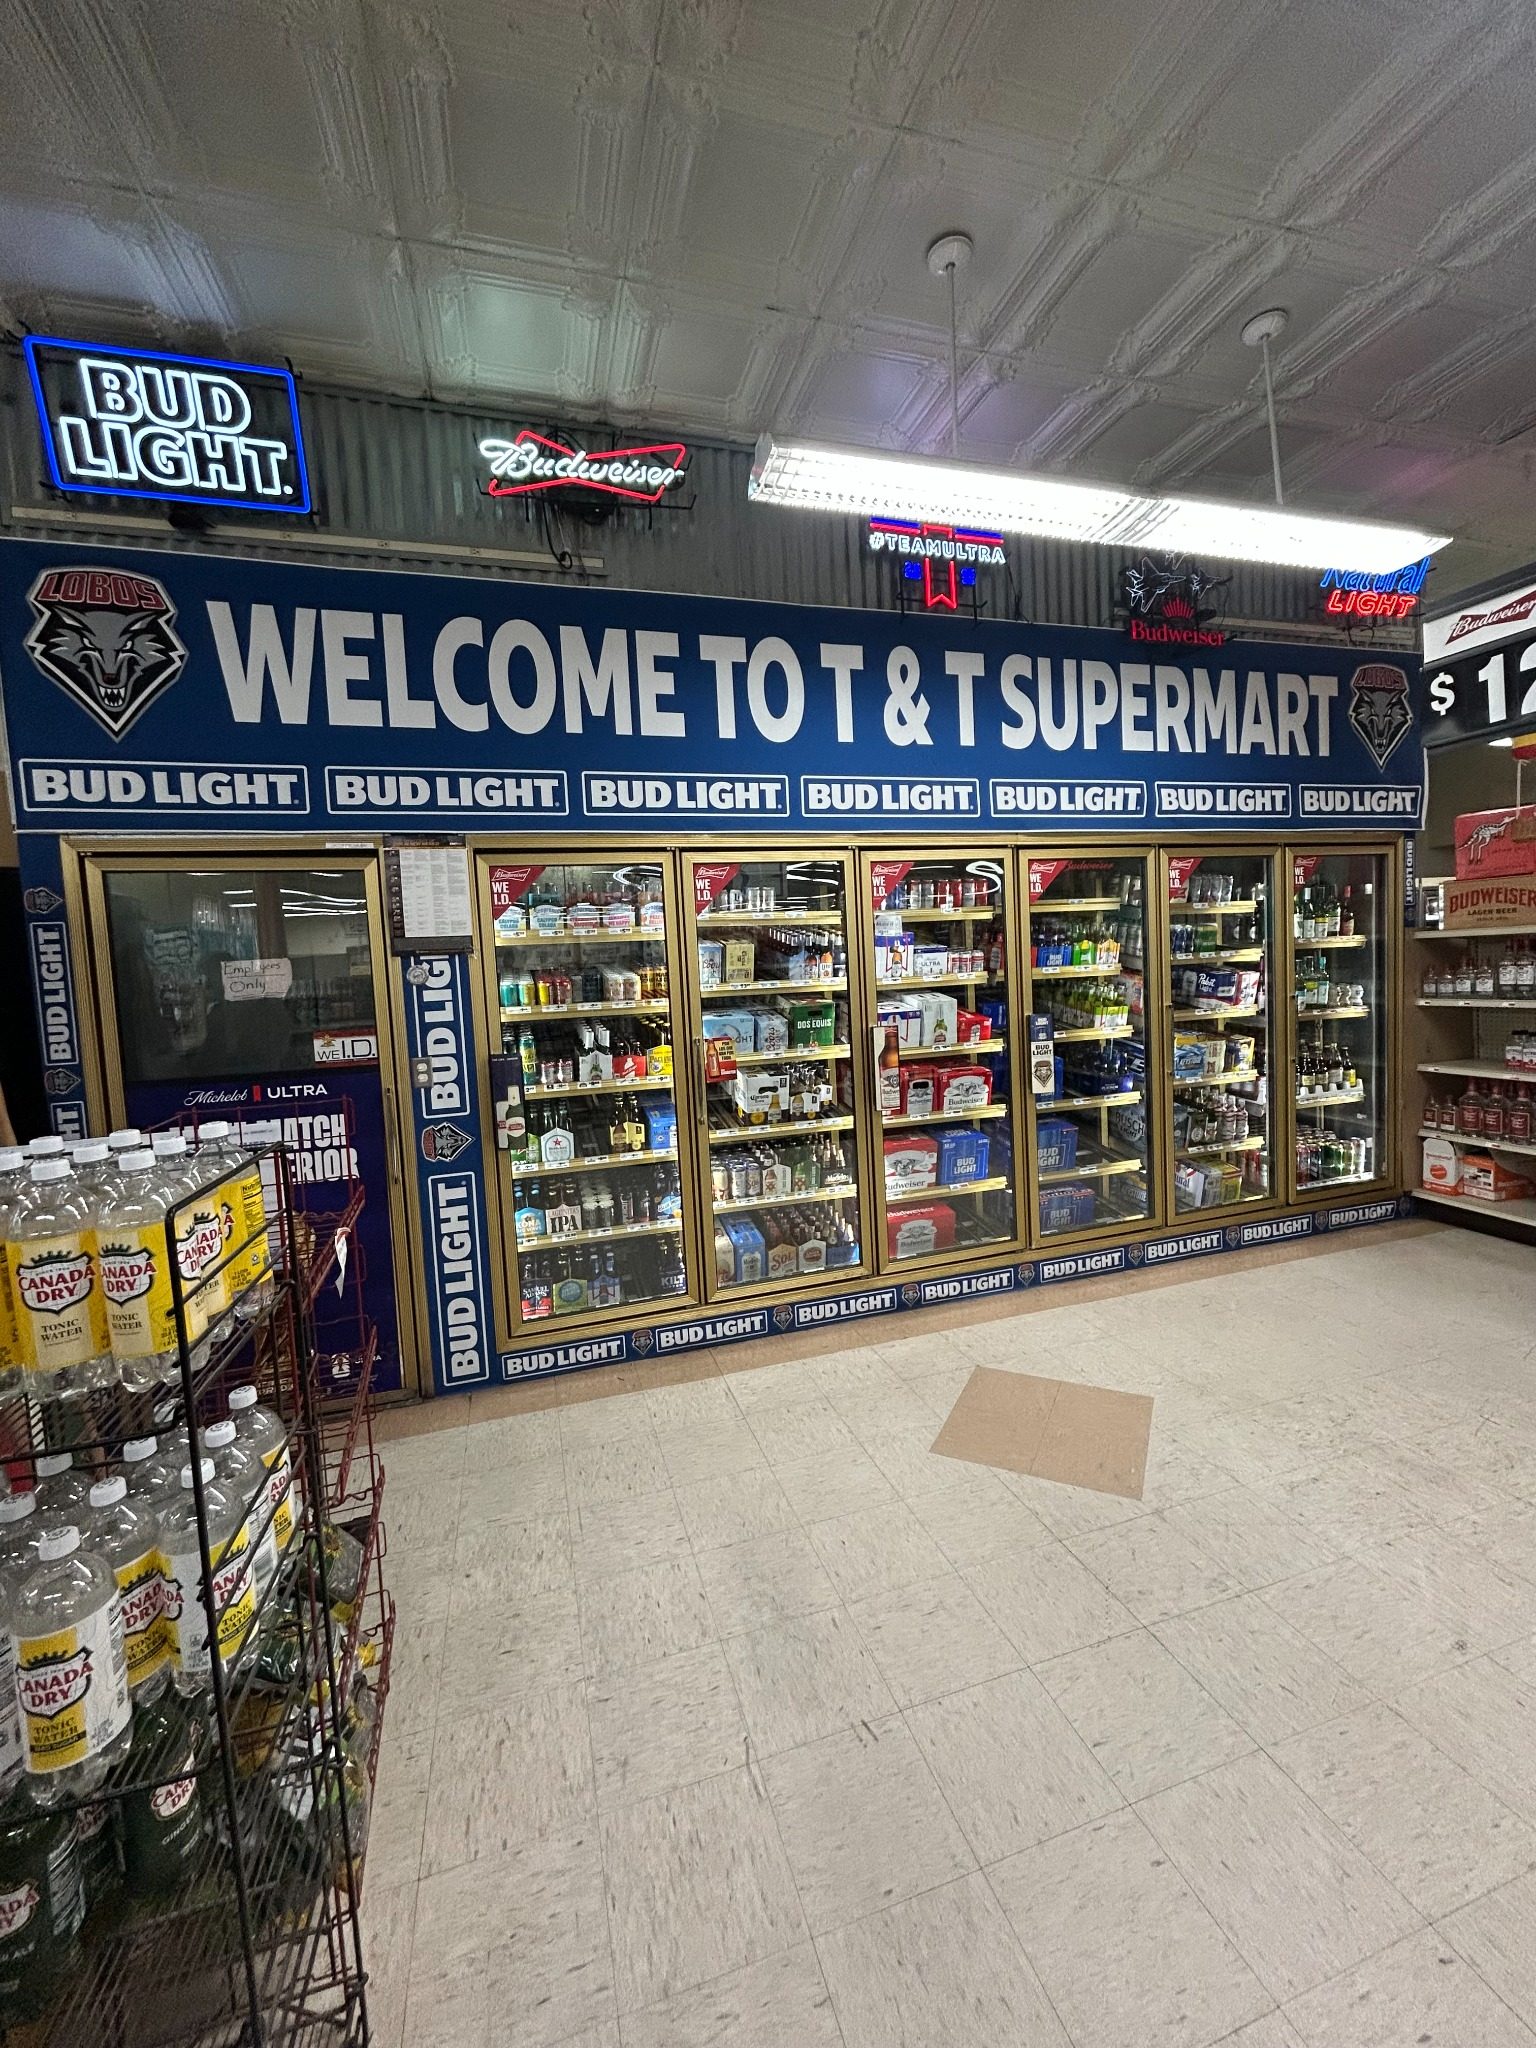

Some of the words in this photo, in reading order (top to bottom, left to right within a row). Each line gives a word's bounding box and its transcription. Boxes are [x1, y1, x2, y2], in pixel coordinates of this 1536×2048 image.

[80, 358, 252, 435] BUD
[479, 437, 685, 487] Budweiser
[869, 532, 1006, 565] #TEAMULTRA
[1320, 556, 1432, 595] Natural
[39, 571, 164, 610] LOBOS
[1328, 589, 1417, 618] LIGHT
[1450, 598, 1536, 637] Budweiser
[1130, 618, 1226, 647] Budweiser
[208, 599, 687, 737] WELCOME
[699, 635, 805, 743] TO
[820, 643, 864, 742] T
[884, 646, 934, 746] &
[945, 651, 985, 746] T
[1001, 653, 1338, 757] SUPERMART
[1430, 671, 1456, 716] $
[31, 769, 146, 803] BUD
[335, 774, 429, 807] BUD
[591, 779, 673, 809] BUD
[808, 783, 882, 811] BUD
[996, 786, 1057, 811] BUD
[1161, 788, 1216, 813] BUD
[1303, 789, 1354, 814] BUD
[1406, 841, 1414, 868] BUD
[872, 876, 886, 887] WE
[1030, 873, 1042, 882] WE
[1169, 870, 1180, 878] WE
[1294, 867, 1305, 876] WE
[492, 882, 509, 893] WE
[695, 879, 711, 889] WE
[873, 887, 888, 897] I.D.
[1405, 870, 1414, 903] LIGHT
[493, 894, 512, 905] I.D.
[697, 890, 713, 901] I.D.
[1449, 887, 1536, 914] BUDWEISER
[37, 927, 67, 1003] LIGHT
[230, 976, 267, 993] Only
[46, 1008, 72, 1061] BUD
[798, 1020, 811, 1029] DOS
[812, 1018, 832, 1028] EQUIS
[317, 1050, 340, 1061] WE
[342, 1039, 376, 1059] I.D.
[426, 1027, 461, 1110] BUD
[184, 1089, 248, 1106] Michelob
[266, 1083, 328, 1099] ULTRA
[948, 1096, 984, 1106] Budweiser
[283, 1113, 347, 1150] ATCH
[290, 1147, 360, 1185] ERIOR
[953, 1164, 977, 1175] LIGHT
[956, 1157, 975, 1167] BUD
[1175, 1174, 1190, 1189] ural
[550, 1213, 579, 1233] IPA
[1050, 1209, 1070, 1220] BUD
[1332, 1209, 1358, 1225] BUD
[195, 1224, 224, 1246] ADA
[1243, 1224, 1273, 1242] BUD
[1147, 1241, 1181, 1258] BUD
[19, 1264, 97, 1292] CANADA
[100, 1260, 157, 1280] ANADA
[661, 1274, 685, 1287] KILT
[1043, 1262, 1077, 1279] BUD
[36, 1284, 79, 1304] DRY
[106, 1278, 138, 1293] DRY
[925, 1282, 964, 1300] BUD
[112, 1312, 139, 1323] TONIC
[799, 1303, 838, 1323] BUD
[41, 1319, 79, 1333] TONIC
[41, 1326, 83, 1343] WATER
[112, 1321, 143, 1331] WATER
[447, 1297, 481, 1378] BUD
[660, 1327, 705, 1348] BUD
[507, 1353, 556, 1376] BUD
[121, 1583, 161, 1617] ANAD
[125, 1603, 159, 1629] DRY
[222, 1600, 250, 1624] TONIC
[31, 1685, 72, 1708] DRY
[33, 1725, 78, 1743] WATER
[34, 1717, 76, 1735] TONIC
[0, 1889, 41, 1916] ADA
